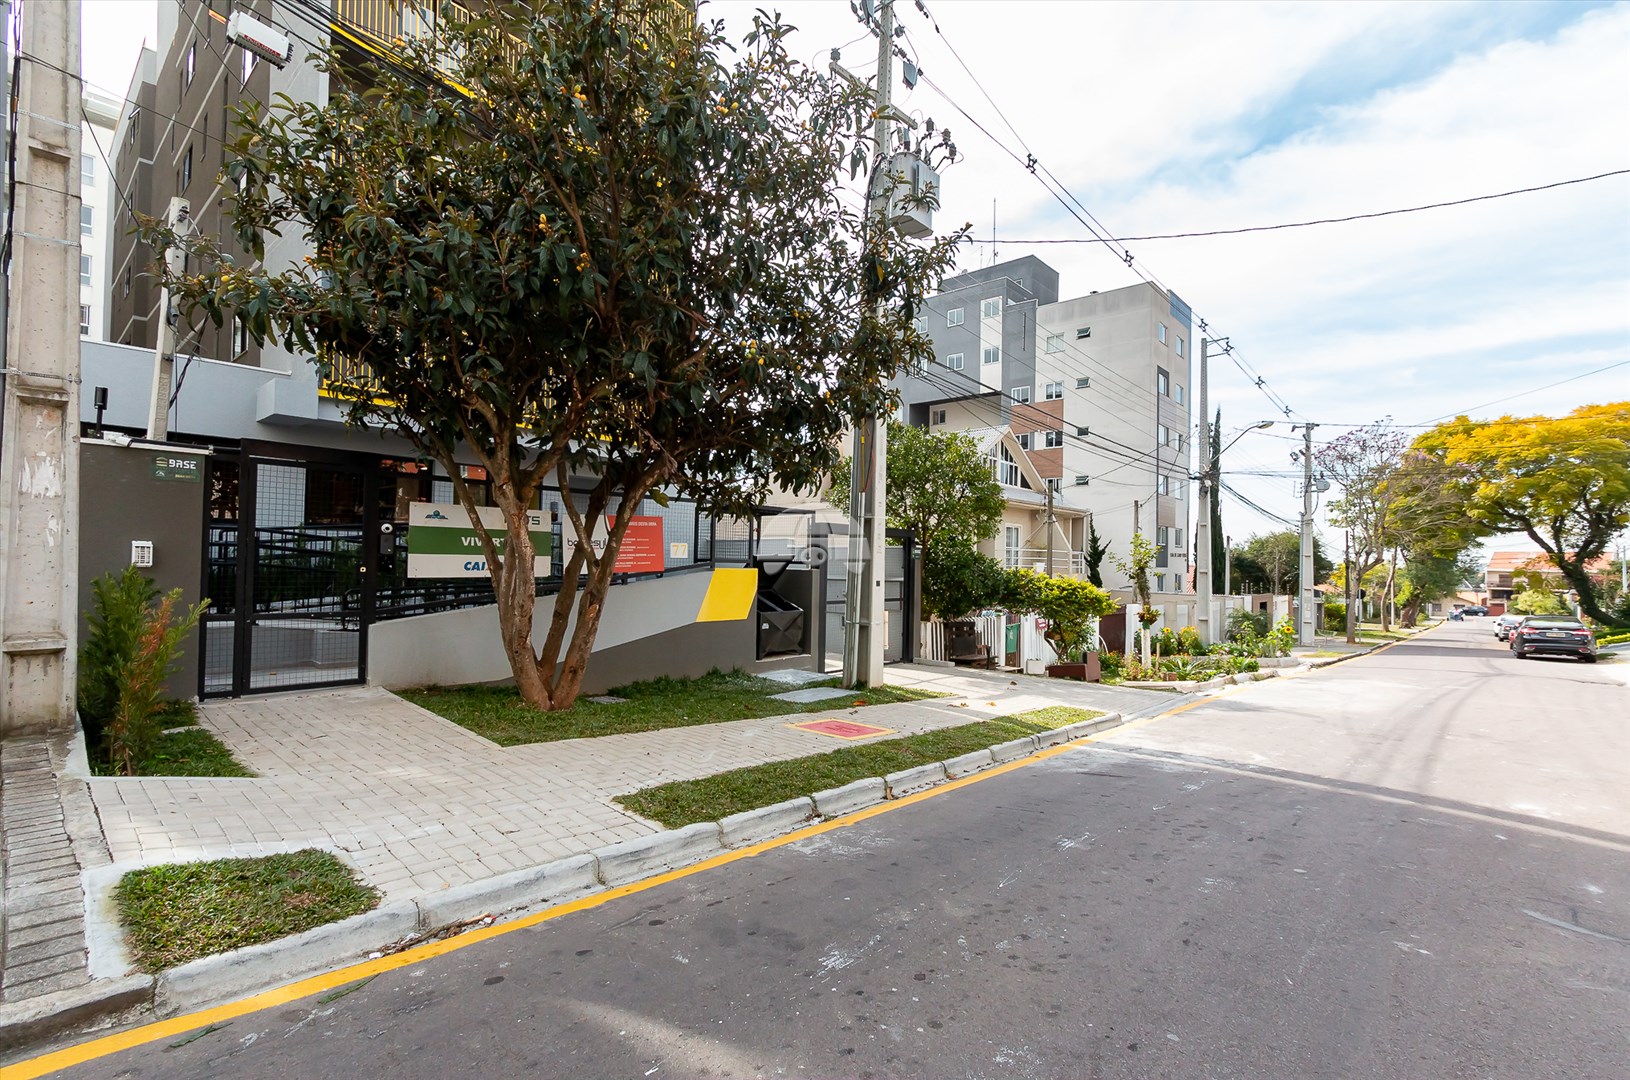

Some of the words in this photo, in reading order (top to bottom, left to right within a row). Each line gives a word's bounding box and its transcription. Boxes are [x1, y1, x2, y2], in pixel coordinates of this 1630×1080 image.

[168, 459, 197, 470] BASE
[461, 536, 505, 547] VIVR
[672, 544, 687, 557] 77
[463, 561, 489, 572] CAI
